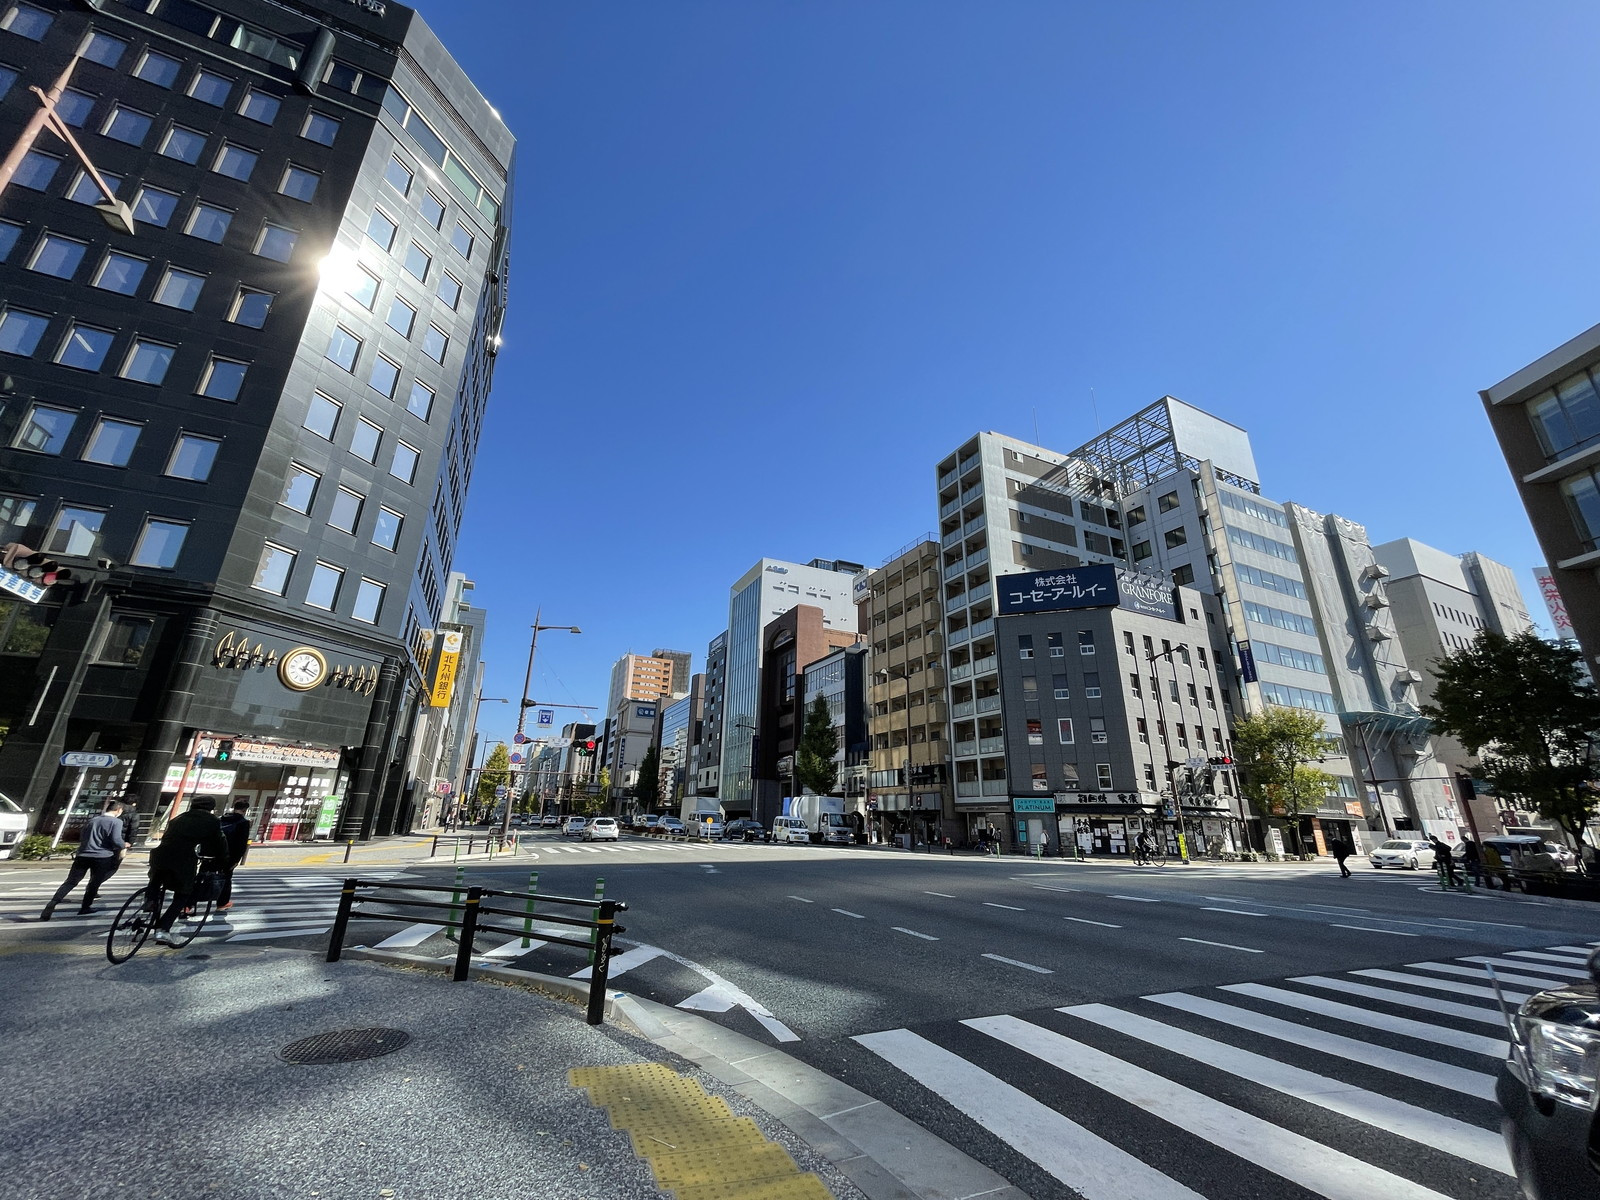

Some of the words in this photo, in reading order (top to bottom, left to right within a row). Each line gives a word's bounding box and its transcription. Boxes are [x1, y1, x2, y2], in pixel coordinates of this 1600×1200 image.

[1034, 573, 1078, 588] 株式会社
[1009, 583, 1107, 605] コーセーアールイー
[1121, 581, 1174, 605] GRANFORE
[1539, 576, 1573, 628] 共栄火災
[437, 654, 455, 700] 北九州銀行
